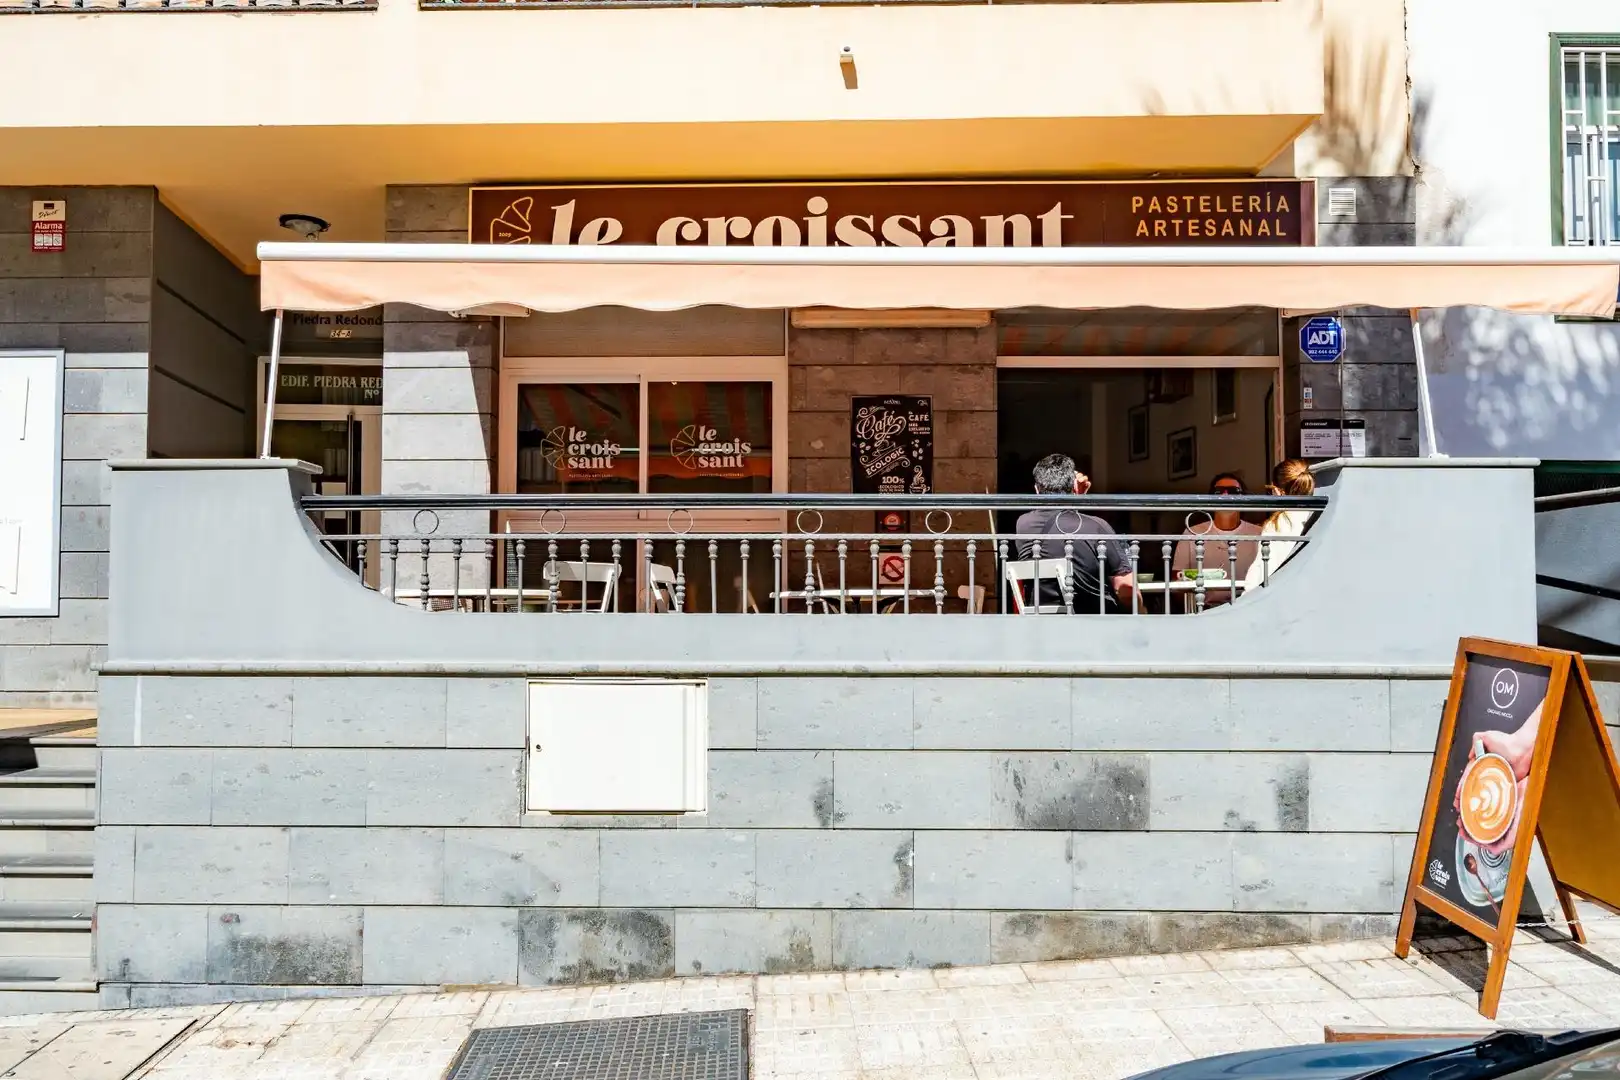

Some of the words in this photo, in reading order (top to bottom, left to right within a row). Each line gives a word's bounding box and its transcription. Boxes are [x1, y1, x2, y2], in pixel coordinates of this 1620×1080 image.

[1131, 192, 1290, 213] PASTELERÍA
[34, 222, 63, 230] Alarma
[551, 199, 623, 246] le
[656, 196, 1074, 247] croissant
[1135, 219, 1287, 237] ARTESANAL
[293, 313, 331, 325] Piedra
[1308, 330, 1337, 345] ADT
[281, 375, 310, 387] EDIF.
[314, 375, 357, 388] PIEDRA
[908, 412, 929, 421] CAFÉ
[568, 426, 587, 442] le
[699, 425, 717, 441] le
[857, 408, 907, 447] Café
[567, 439, 621, 456] crois
[567, 455, 614, 469] sant
[698, 453, 744, 468] sant
[866, 447, 905, 476] ECOLOGIC
[882, 476, 905, 484] 100%
[1496, 681, 1514, 696] OM
